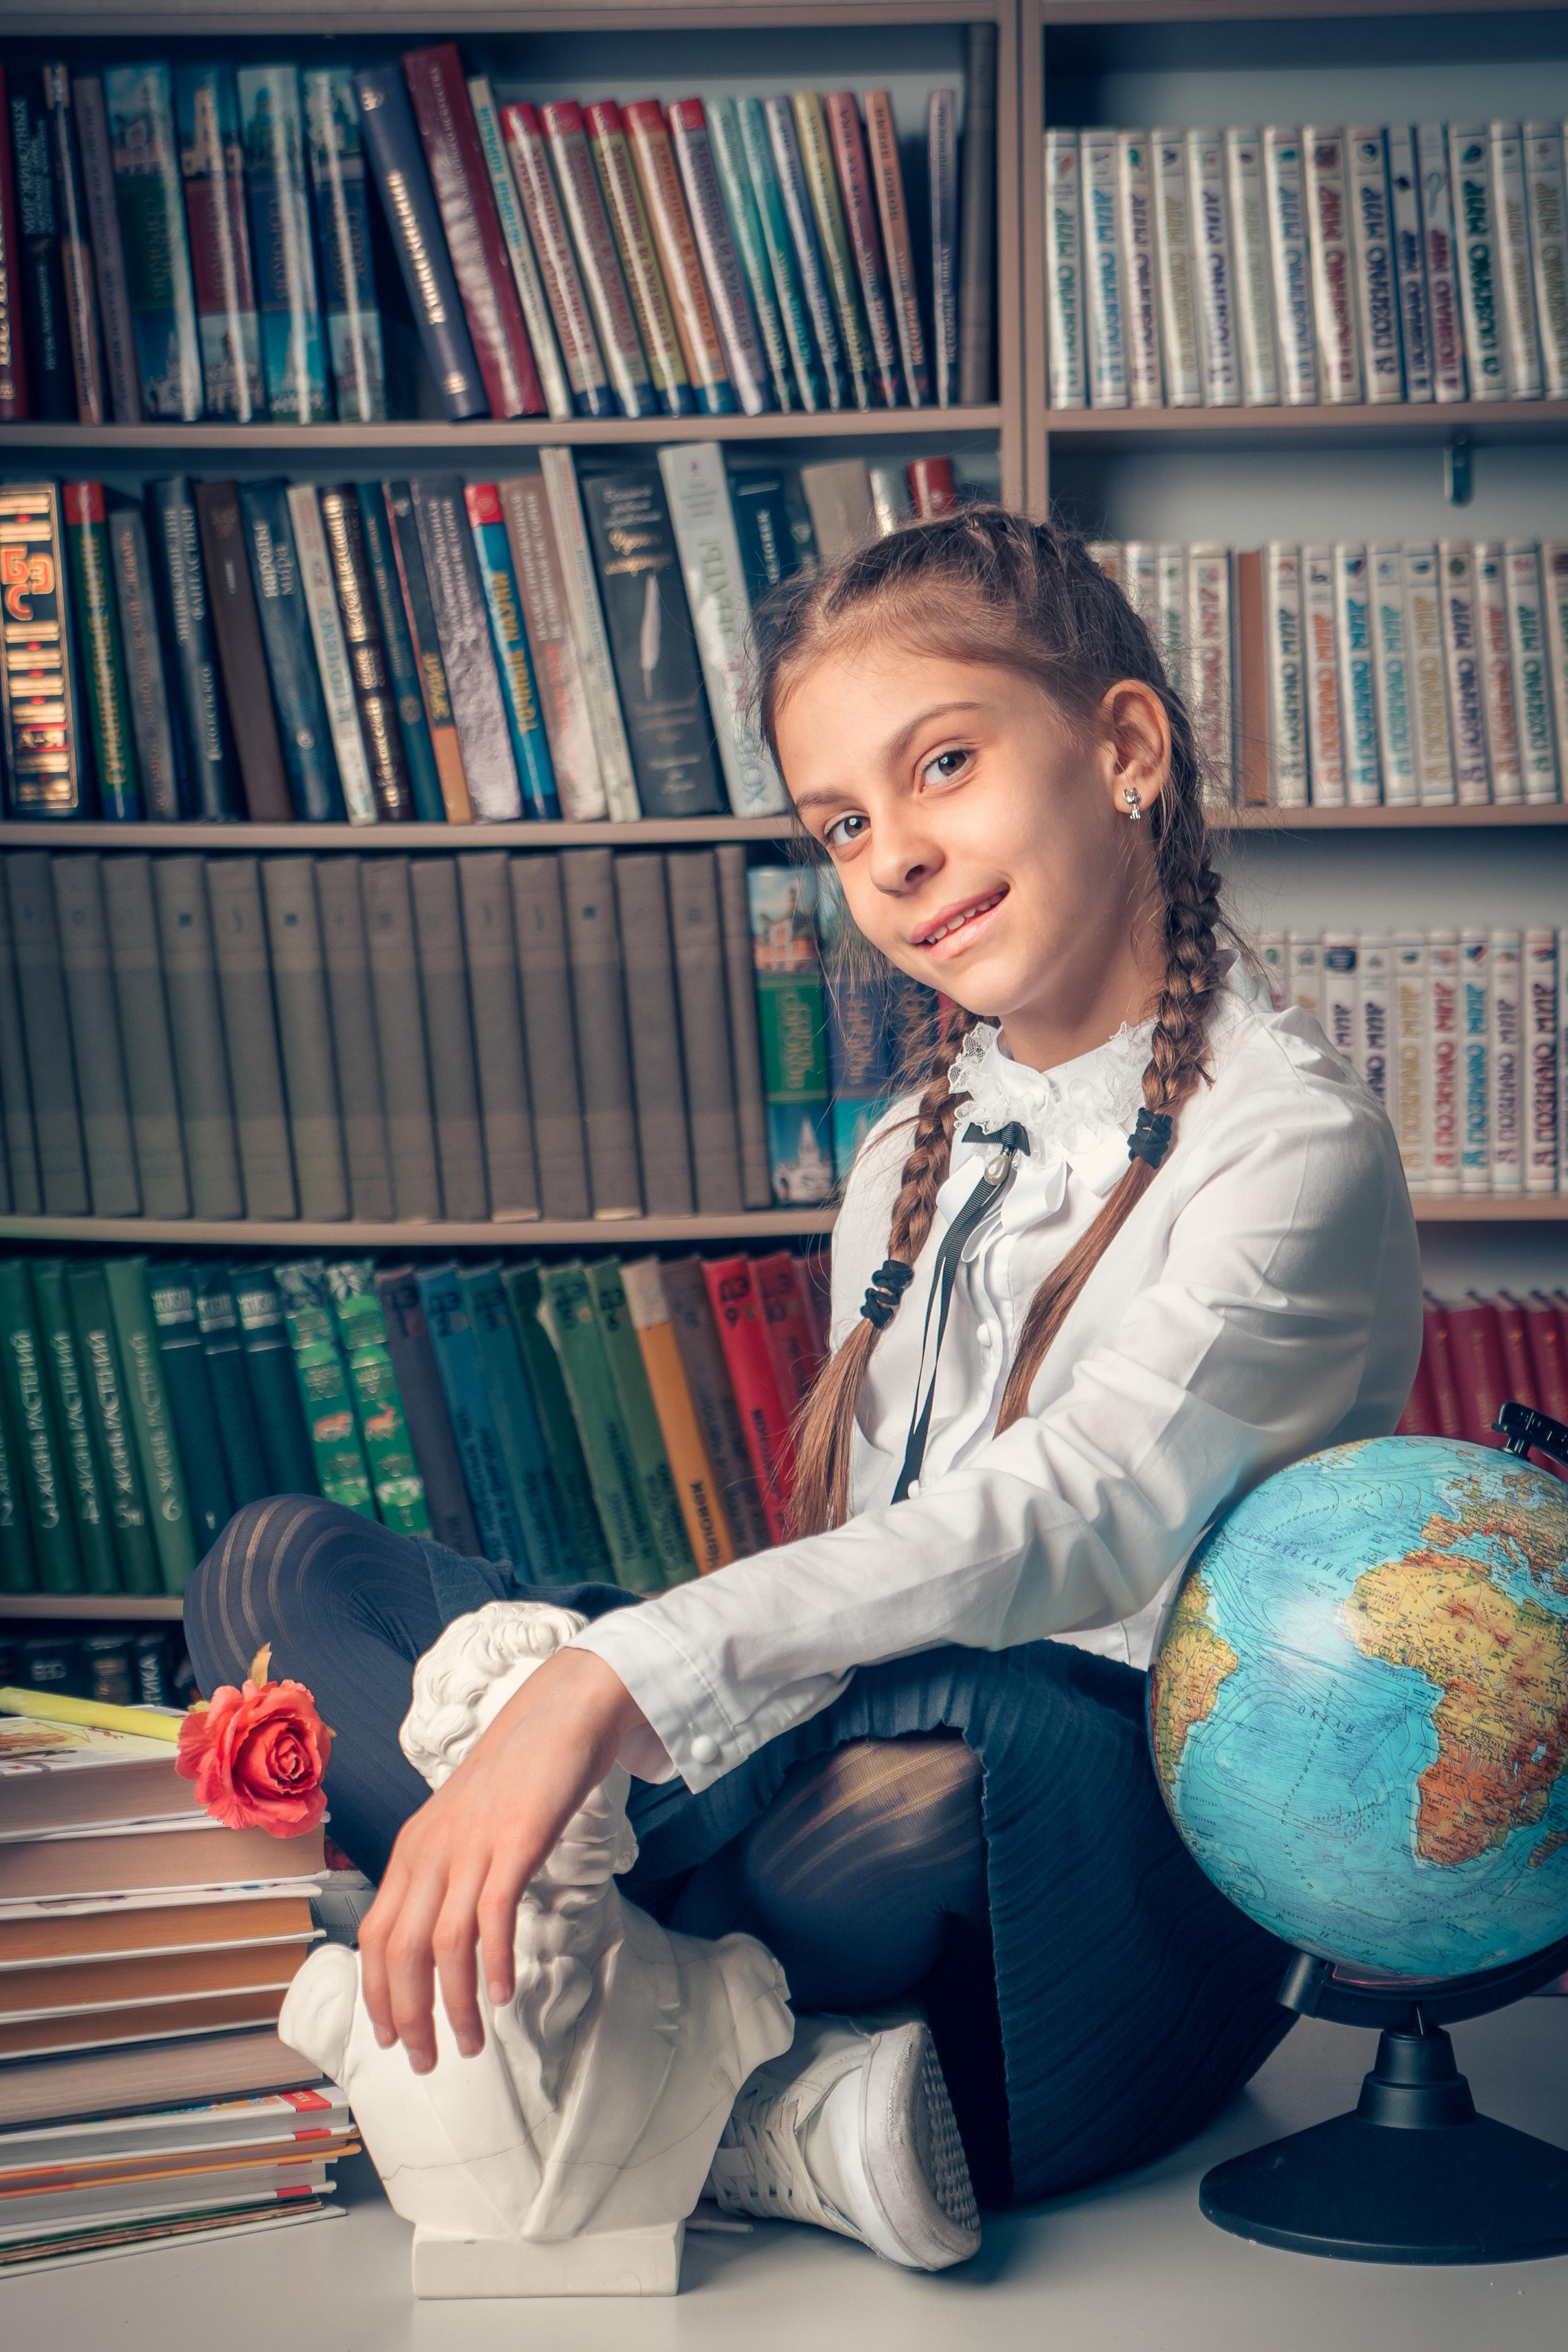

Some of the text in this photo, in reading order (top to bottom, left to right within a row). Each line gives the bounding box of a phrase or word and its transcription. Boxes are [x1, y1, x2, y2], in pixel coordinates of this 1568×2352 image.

[11, 96, 38, 234] МИР ЖИВОТНЫХ
[1054, 207, 1075, 259] МИР
[1127, 193, 1148, 247] МИР
[1163, 194, 1185, 246] МИР
[1200, 191, 1224, 246] МИР
[1278, 186, 1301, 241] МИР
[1318, 186, 1342, 241] МИР
[1359, 186, 1385, 241] МИР
[1463, 179, 1485, 238] МИР
[1534, 183, 1559, 239] МИР
[1090, 189, 1121, 358] ПОЗНАЮ МИР
[1365, 247, 1394, 350] ПОЗНАЮ
[1429, 229, 1457, 372] ПОЗНАЮ МИР
[1468, 243, 1499, 350] ПОЗНАЮ
[904, 297, 924, 366] ИСТОРИЯ
[253, 519, 280, 598] народы
[443, 499, 462, 559] ИСТОРИЯ
[526, 494, 548, 557] ИСТОРИЯ
[1, 542, 55, 622] БЭС
[121, 530, 139, 597] СЛОВАРЬ
[164, 508, 189, 645] ЭНЦИКЛОПЕДИЯ
[181, 508, 205, 620] ФАНТАСТИКИ
[277, 544, 294, 596] мира
[427, 499, 467, 643] ИЛЛЮСТРИРОВАННАЯ
[511, 494, 549, 641] ИЛЛЮСТРИРОВАННАЯ
[536, 560, 562, 638] ВСЕМИРНАЯ
[1200, 587, 1221, 639] МИР
[1277, 607, 1298, 658] МИР
[1344, 599, 1369, 649] МИР
[1412, 596, 1439, 647] МИР
[1449, 597, 1474, 650] МИР
[318, 606, 346, 699] ПОЧЕМУ
[421, 651, 450, 718] ЭРУДИТ
[491, 570, 538, 734] ТОЧНЫЕ НАУКИ
[1379, 606, 1409, 755] ПОЗНАЮ МИР
[1483, 606, 1517, 755] ПОЗНАЮ МИР
[1516, 605, 1550, 751] ПОЗНАЮ МИР
[88, 612, 127, 785] ГУМАНИТАРНЫЕ
[1310, 611, 1341, 763] ПОЗНАЮ МИР
[1350, 660, 1374, 761] ПОЗНАЮ
[1419, 655, 1449, 759] ПОЗНАЮ
[1455, 658, 1483, 760] ПОЗНАЮ
[733, 728, 767, 805] ХОЧУ
[1332, 1003, 1353, 1047] МИР
[1365, 1001, 1385, 1050] МИР
[1400, 986, 1423, 1038] МИР
[1433, 982, 1456, 1033] МИР
[1464, 982, 1487, 1035] МИР
[1497, 998, 1517, 1045] МИР
[1532, 982, 1558, 1033] МИР
[1399, 1043, 1426, 1148] ПОЗНАЮ
[1434, 1041, 1457, 1148] ПОЗНАЮ
[1464, 1043, 1487, 1147] ПОЗНАЮ
[1496, 1053, 1517, 1144] ПОЗНАЮ
[1534, 1042, 1558, 1144] ПОЗНАЮ
[717, 1276, 751, 1303] ДЭ
[723, 1302, 739, 1329] 9
[9, 1329, 55, 1498] ЖИЗНЬ РАСТЕНИЙ
[49, 1330, 94, 1496] ЖИЗНЬ РАСТЕНИЙ
[85, 1328, 134, 1496] ЖИЗНЬ РАСТЕНИЙ
[127, 1332, 175, 1493] ЖИЗНЬ РАСТЕНИЙ
[40, 1499, 61, 1529] 3
[80, 1494, 101, 1526] 4
[160, 1495, 183, 1522] 6
[689, 1481, 720, 1569] Человек
[1297, 1705, 1354, 1735] ОКЕАН
[1452, 1811, 1477, 1824] БОТСВАНА
[1283, 1842, 1314, 1890] хребет
